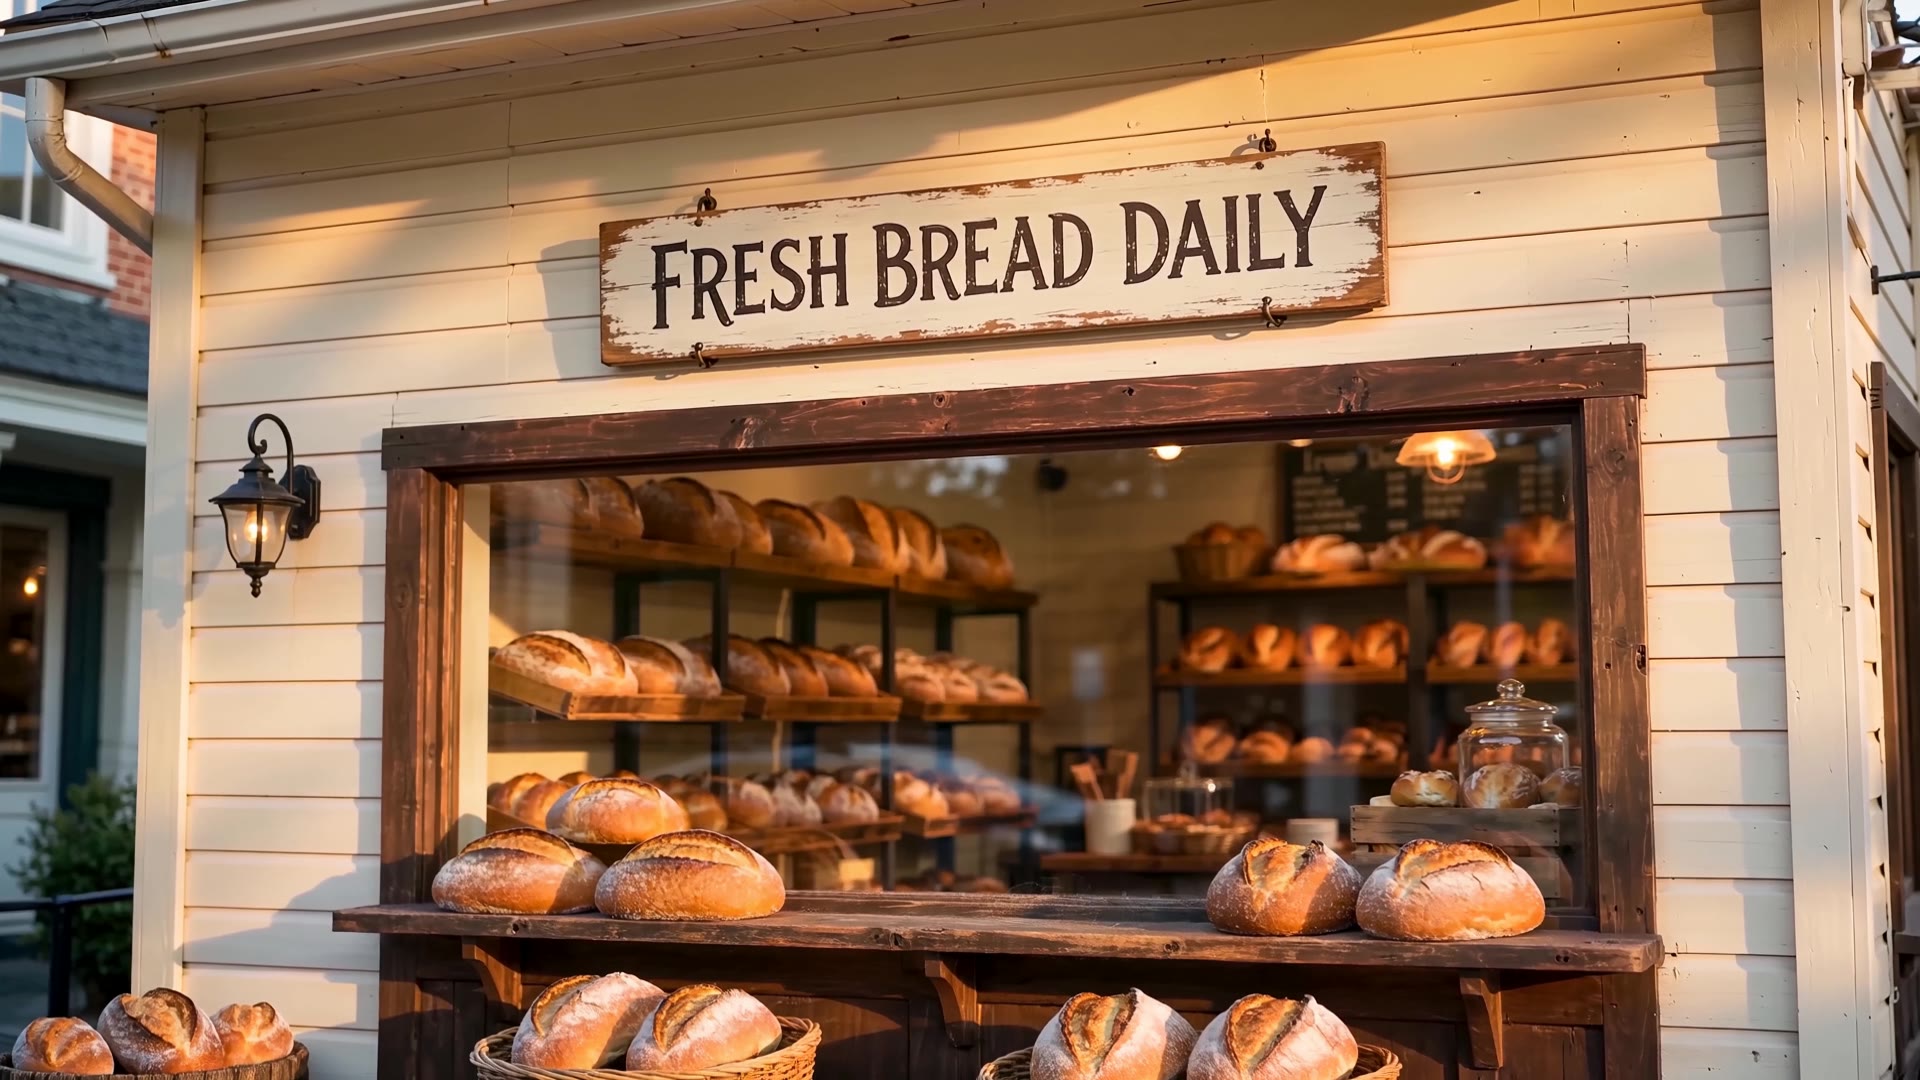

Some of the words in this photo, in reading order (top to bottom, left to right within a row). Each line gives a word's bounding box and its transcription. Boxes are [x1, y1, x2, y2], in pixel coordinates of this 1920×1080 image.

[651, 232, 850, 330] FRESH
[872, 213, 1094, 309] BREAD
[1119, 185, 1328, 285] DAILY
